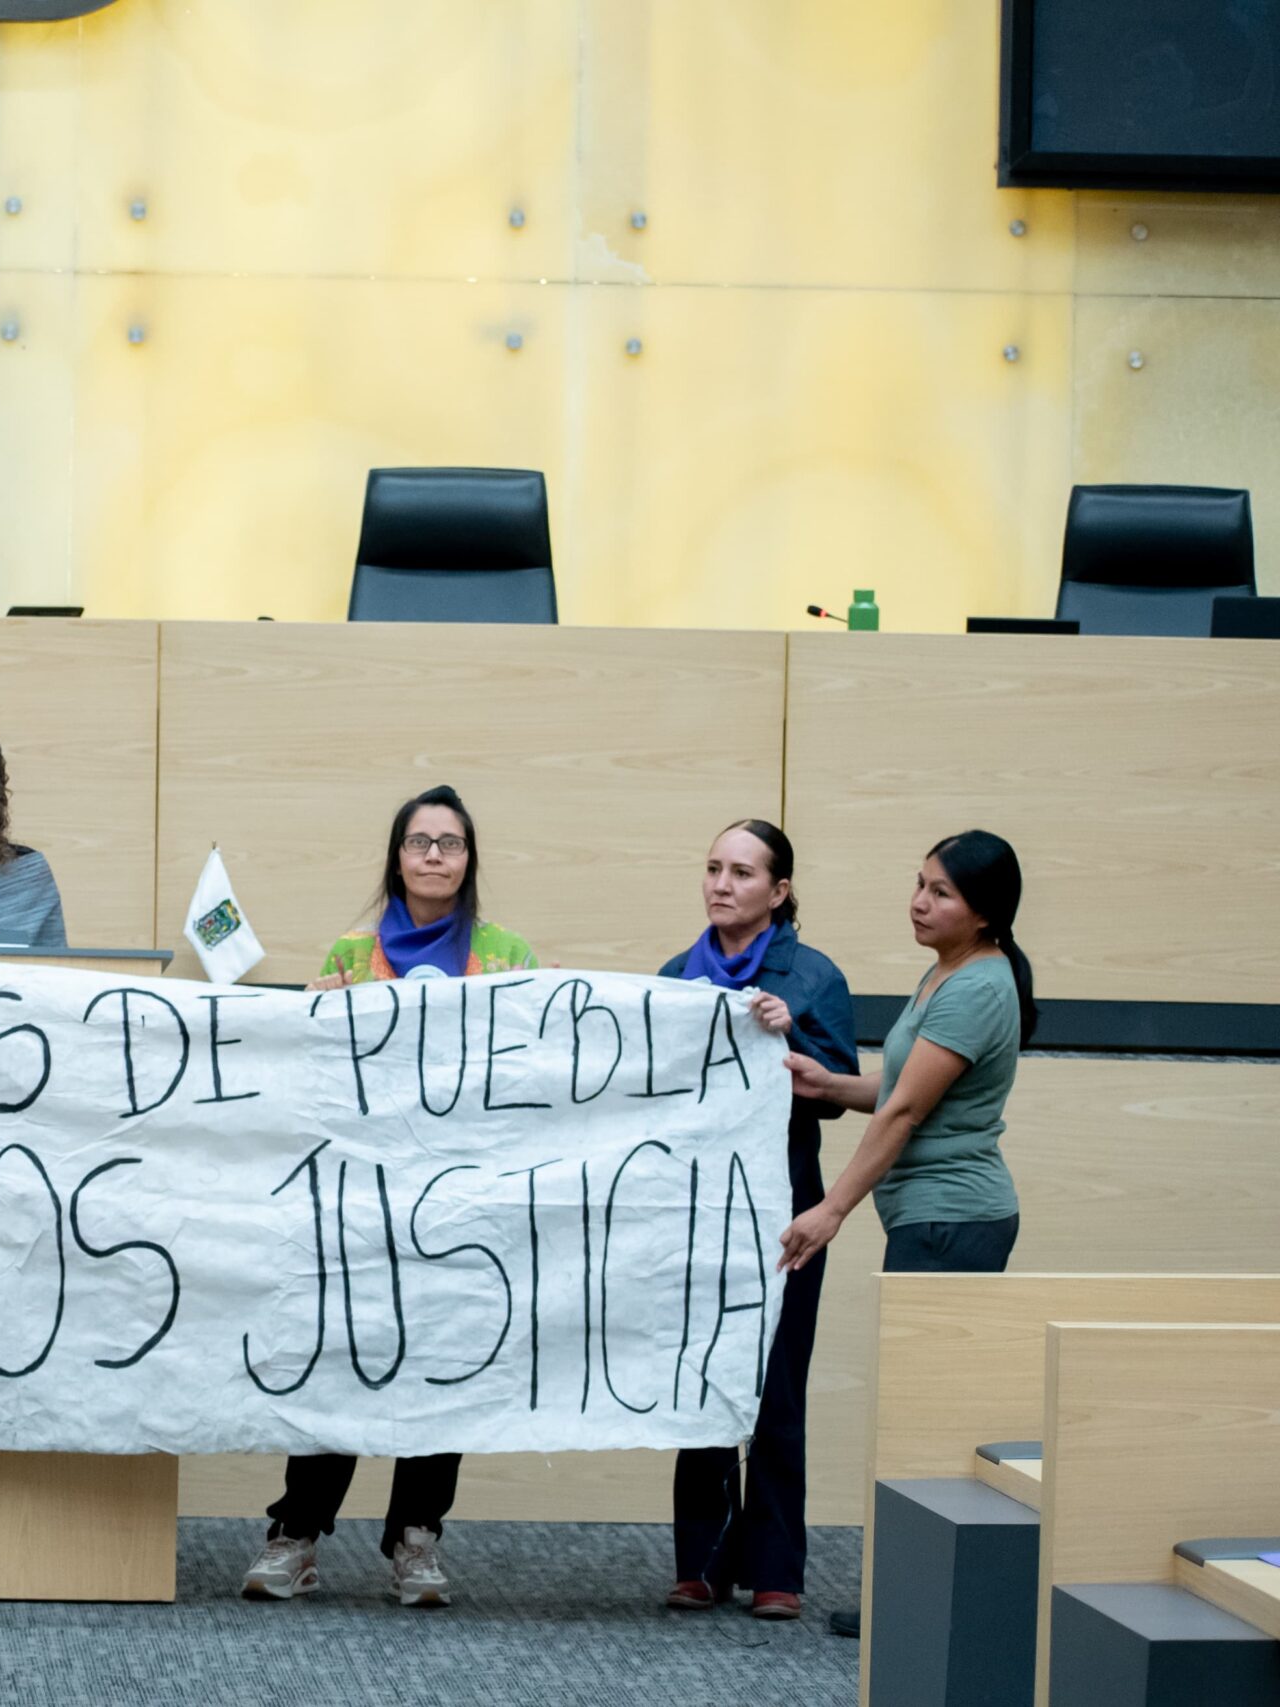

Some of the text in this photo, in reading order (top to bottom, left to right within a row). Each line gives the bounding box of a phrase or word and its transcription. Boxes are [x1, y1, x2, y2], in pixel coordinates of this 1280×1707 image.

[84, 988, 262, 1118] DE
[311, 978, 750, 1116] PUEBLA
[244, 1139, 768, 1413] JUSTICIA
